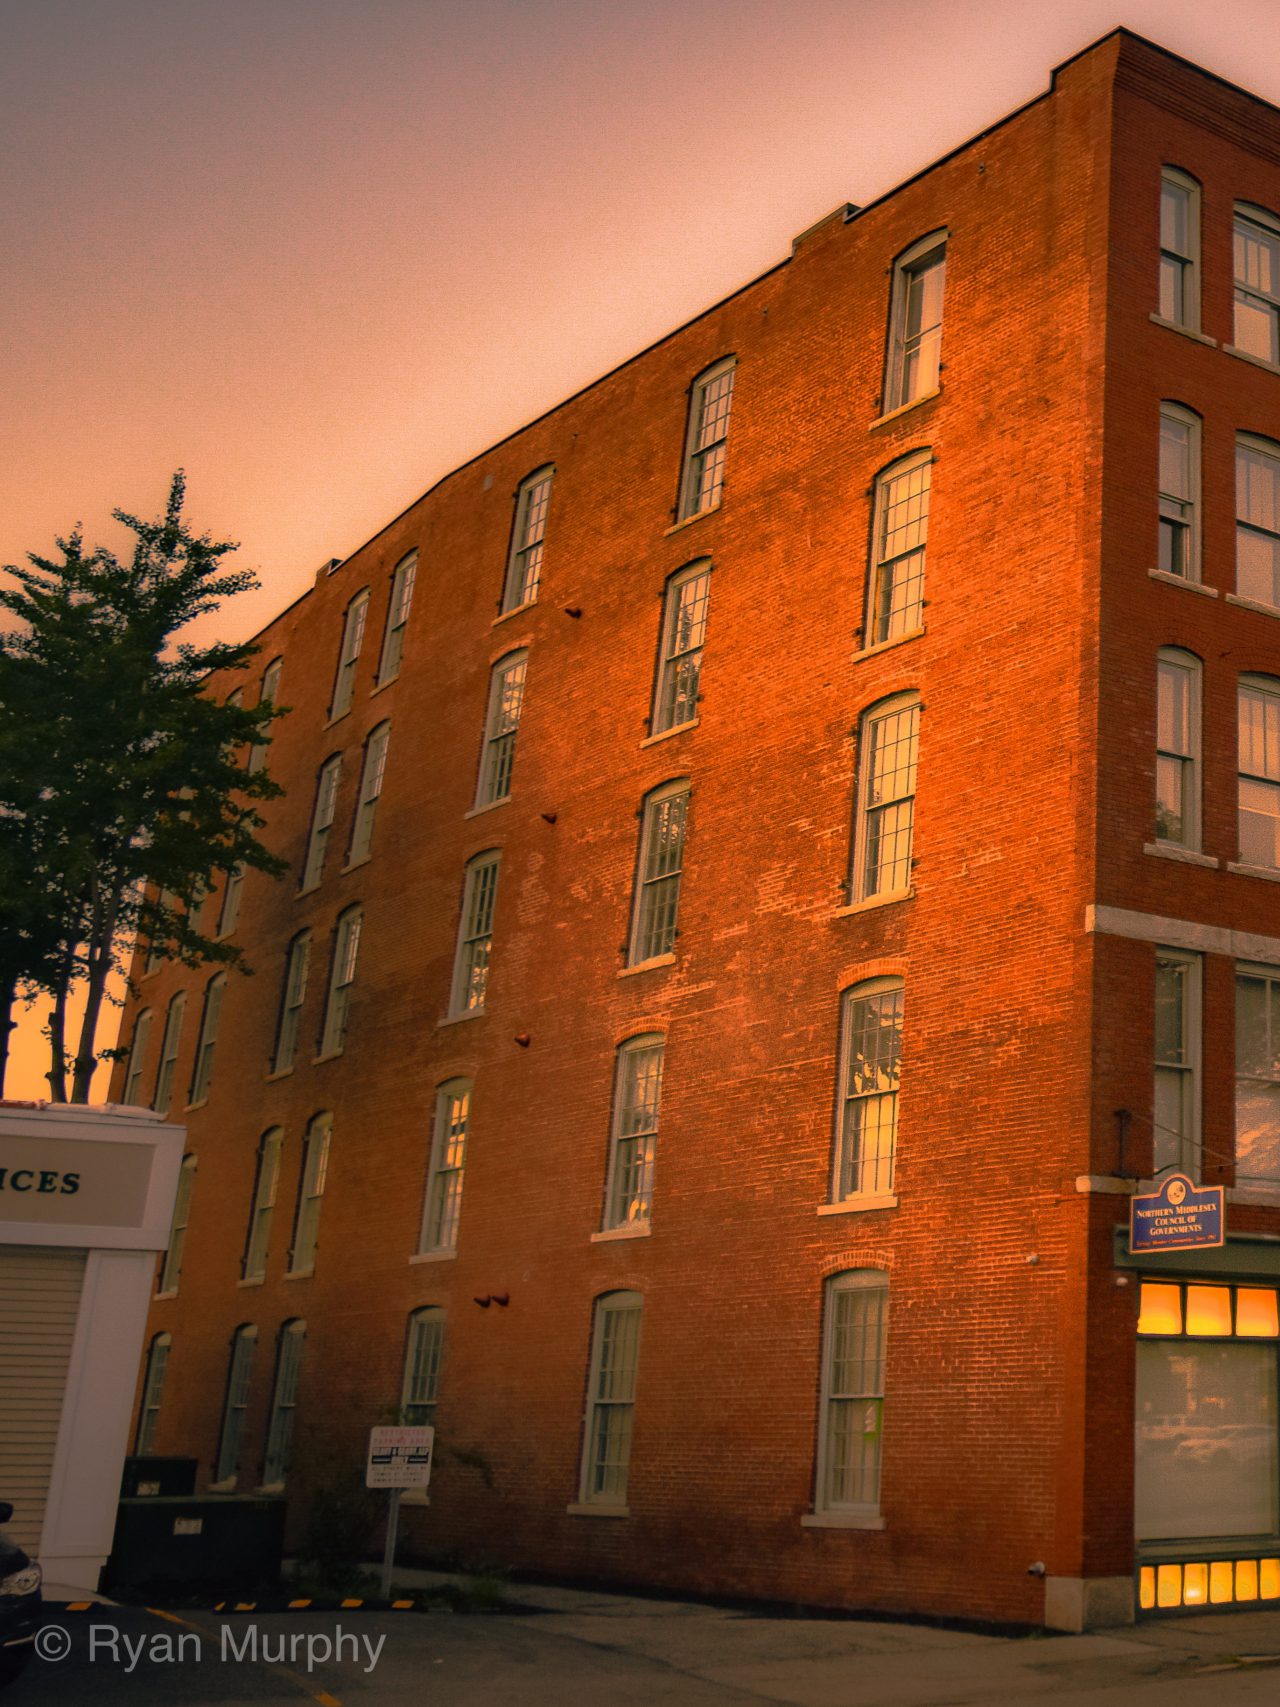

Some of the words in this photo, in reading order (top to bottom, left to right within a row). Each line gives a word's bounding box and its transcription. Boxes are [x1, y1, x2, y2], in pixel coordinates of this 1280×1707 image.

[0, 1168, 80, 1194] ICES
[1154, 1217, 1186, 1227] COUNCIL
[1150, 1224, 1202, 1236] GOVERNMENTS
